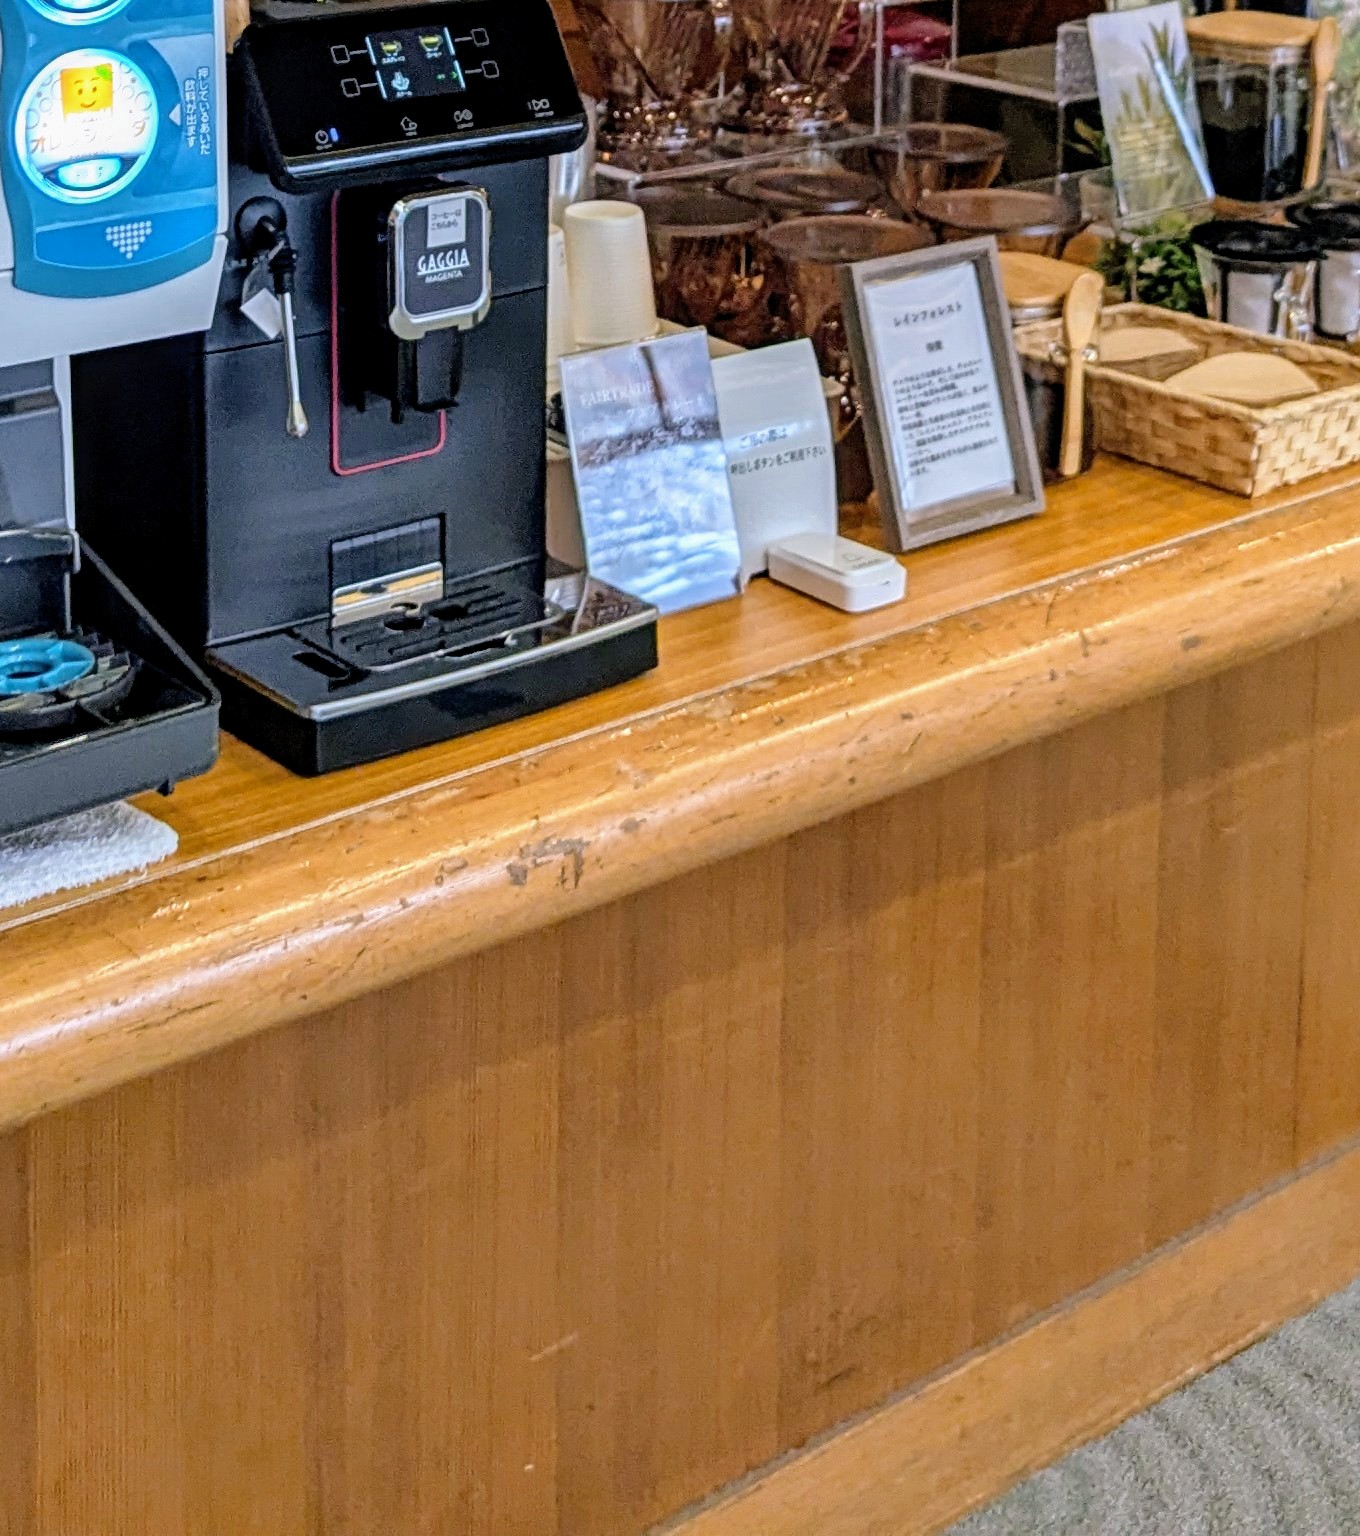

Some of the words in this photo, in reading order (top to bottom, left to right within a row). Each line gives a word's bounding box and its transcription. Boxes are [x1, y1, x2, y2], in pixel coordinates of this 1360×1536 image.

[184, 79, 197, 148] 飲料が出ます
[198, 68, 211, 155] 押しているあいだ
[417, 248, 470, 272] GAGGIA
[425, 270, 463, 283] MAGENTA
